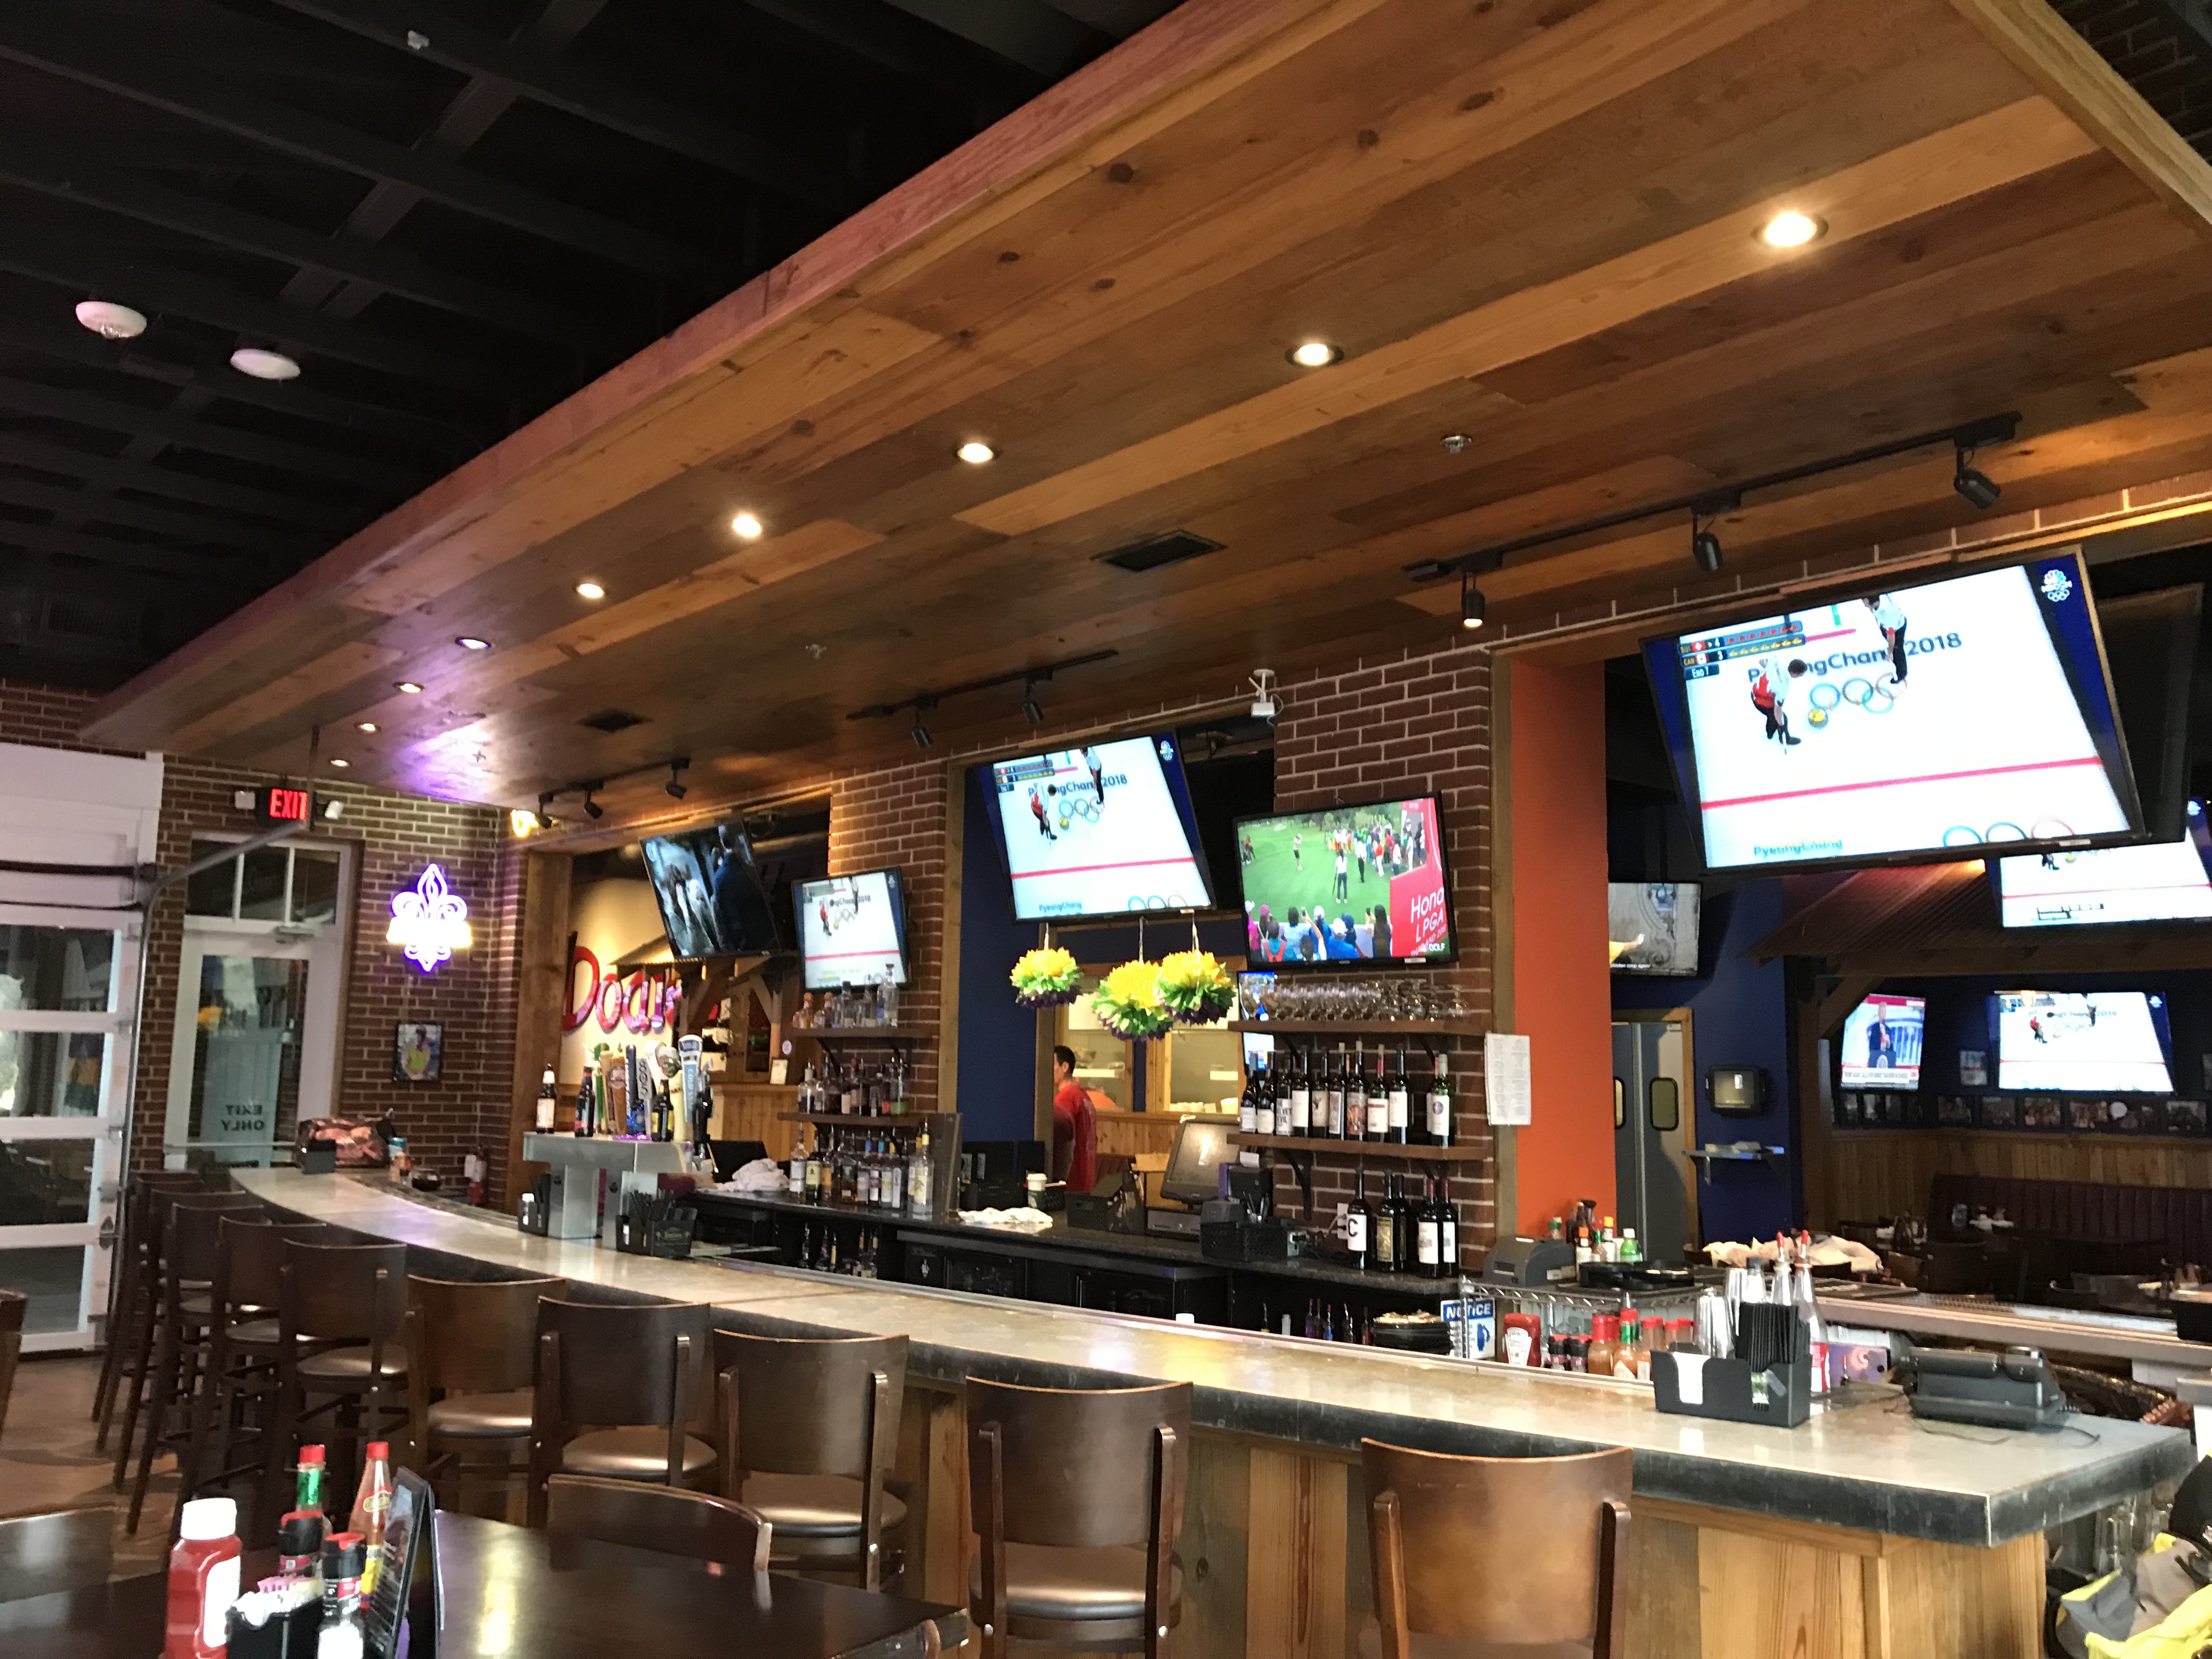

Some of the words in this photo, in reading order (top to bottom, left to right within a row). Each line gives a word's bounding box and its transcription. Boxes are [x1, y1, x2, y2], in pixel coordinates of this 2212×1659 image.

[1904, 632, 1962, 657] 2018
[1102, 773, 1128, 788] 2018
[269, 788, 308, 821] EXIT
[1416, 907, 1444, 943] LPGA
[638, 1058, 649, 1094] 805
[1347, 1218, 1358, 1237] C
